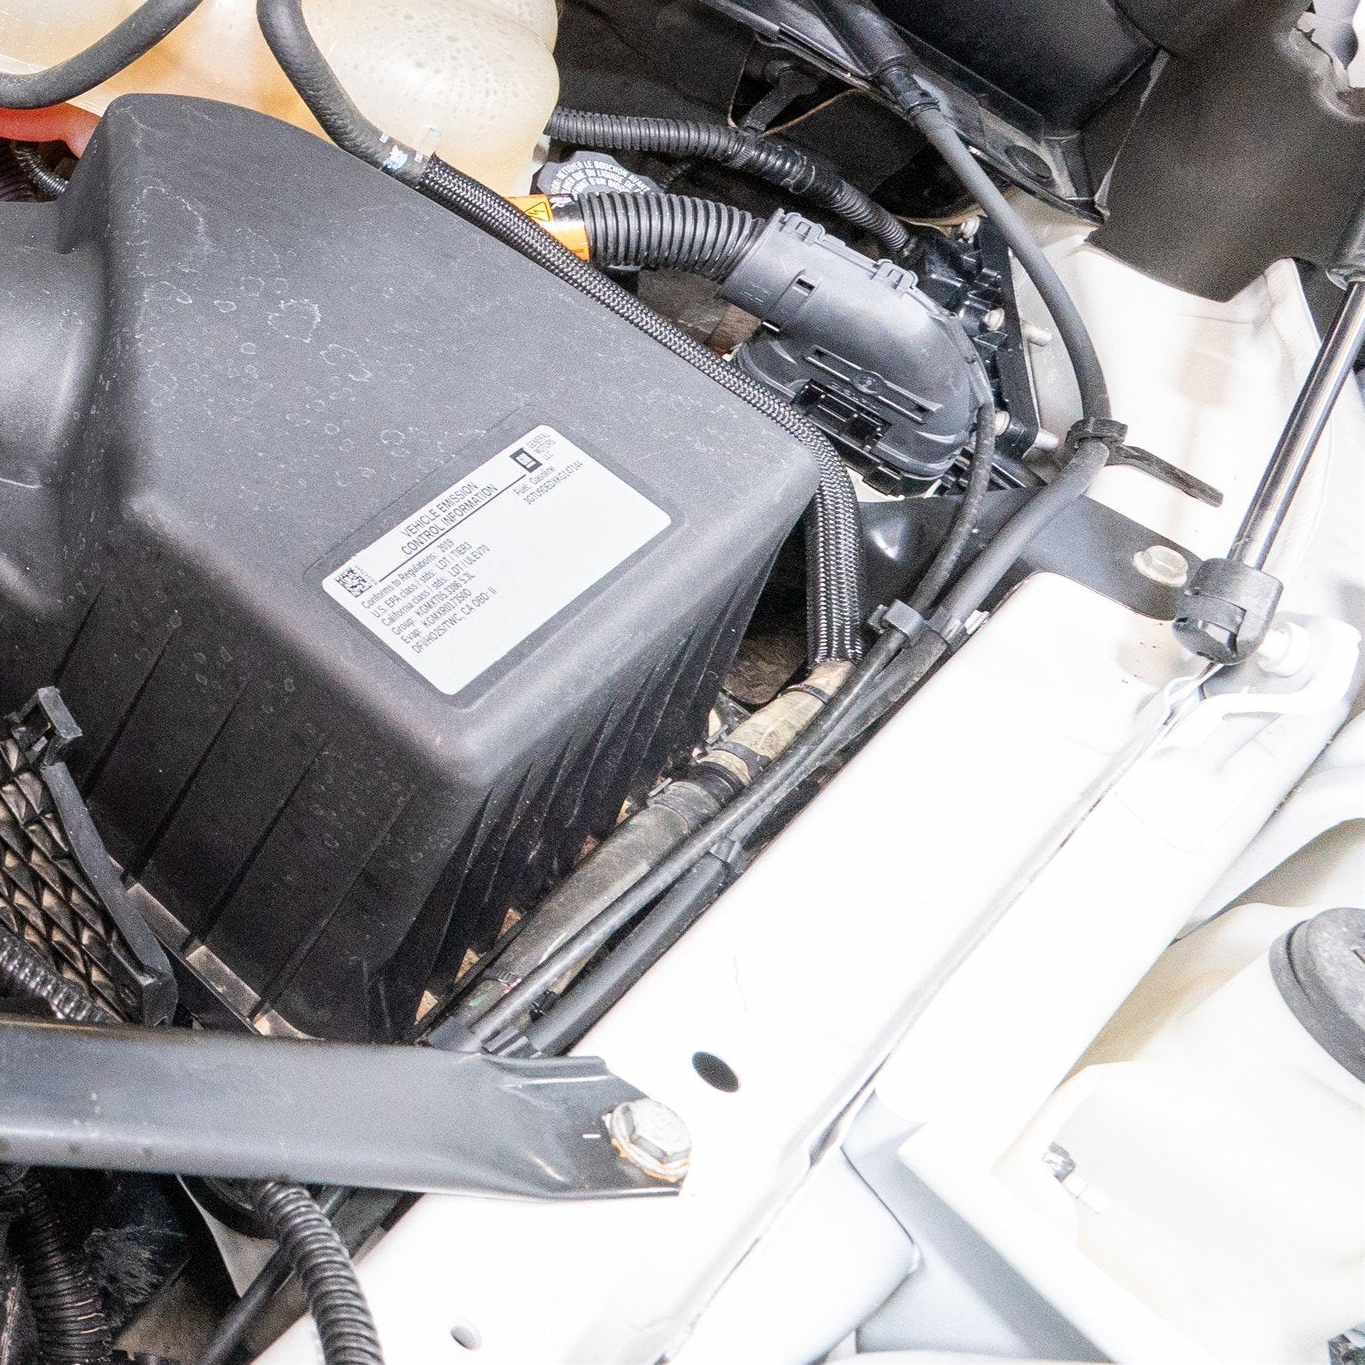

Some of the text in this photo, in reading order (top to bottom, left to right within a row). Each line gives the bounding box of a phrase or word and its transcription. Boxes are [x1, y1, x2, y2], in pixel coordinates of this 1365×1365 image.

[583, 160, 593, 168] LE
[627, 173, 650, 191] AVANT
[533, 439, 556, 454] MOTORS
[529, 466, 556, 486] Gasoline
[402, 481, 478, 538] VEHICLE EMISSION
[402, 484, 498, 555] CONTROL INFORMATION
[362, 584, 394, 609] Conforms
[393, 578, 401, 587] to
[398, 553, 438, 583] Regulations:
[437, 539, 454, 553] 2019
[371, 606, 387, 618] U.S.
[386, 596, 402, 608] EPA
[401, 583, 419, 598] class
[435, 557, 451, 571] LDT
[453, 542, 472, 558] TIER3
[381, 604, 414, 627] California
[411, 590, 429, 606] class
[448, 563, 463, 578] LDT
[465, 545, 490, 566] ULEV70
[461, 603, 474, 615] CA
[392, 617, 415, 636] Group:
[401, 629, 422, 645] Evap:
